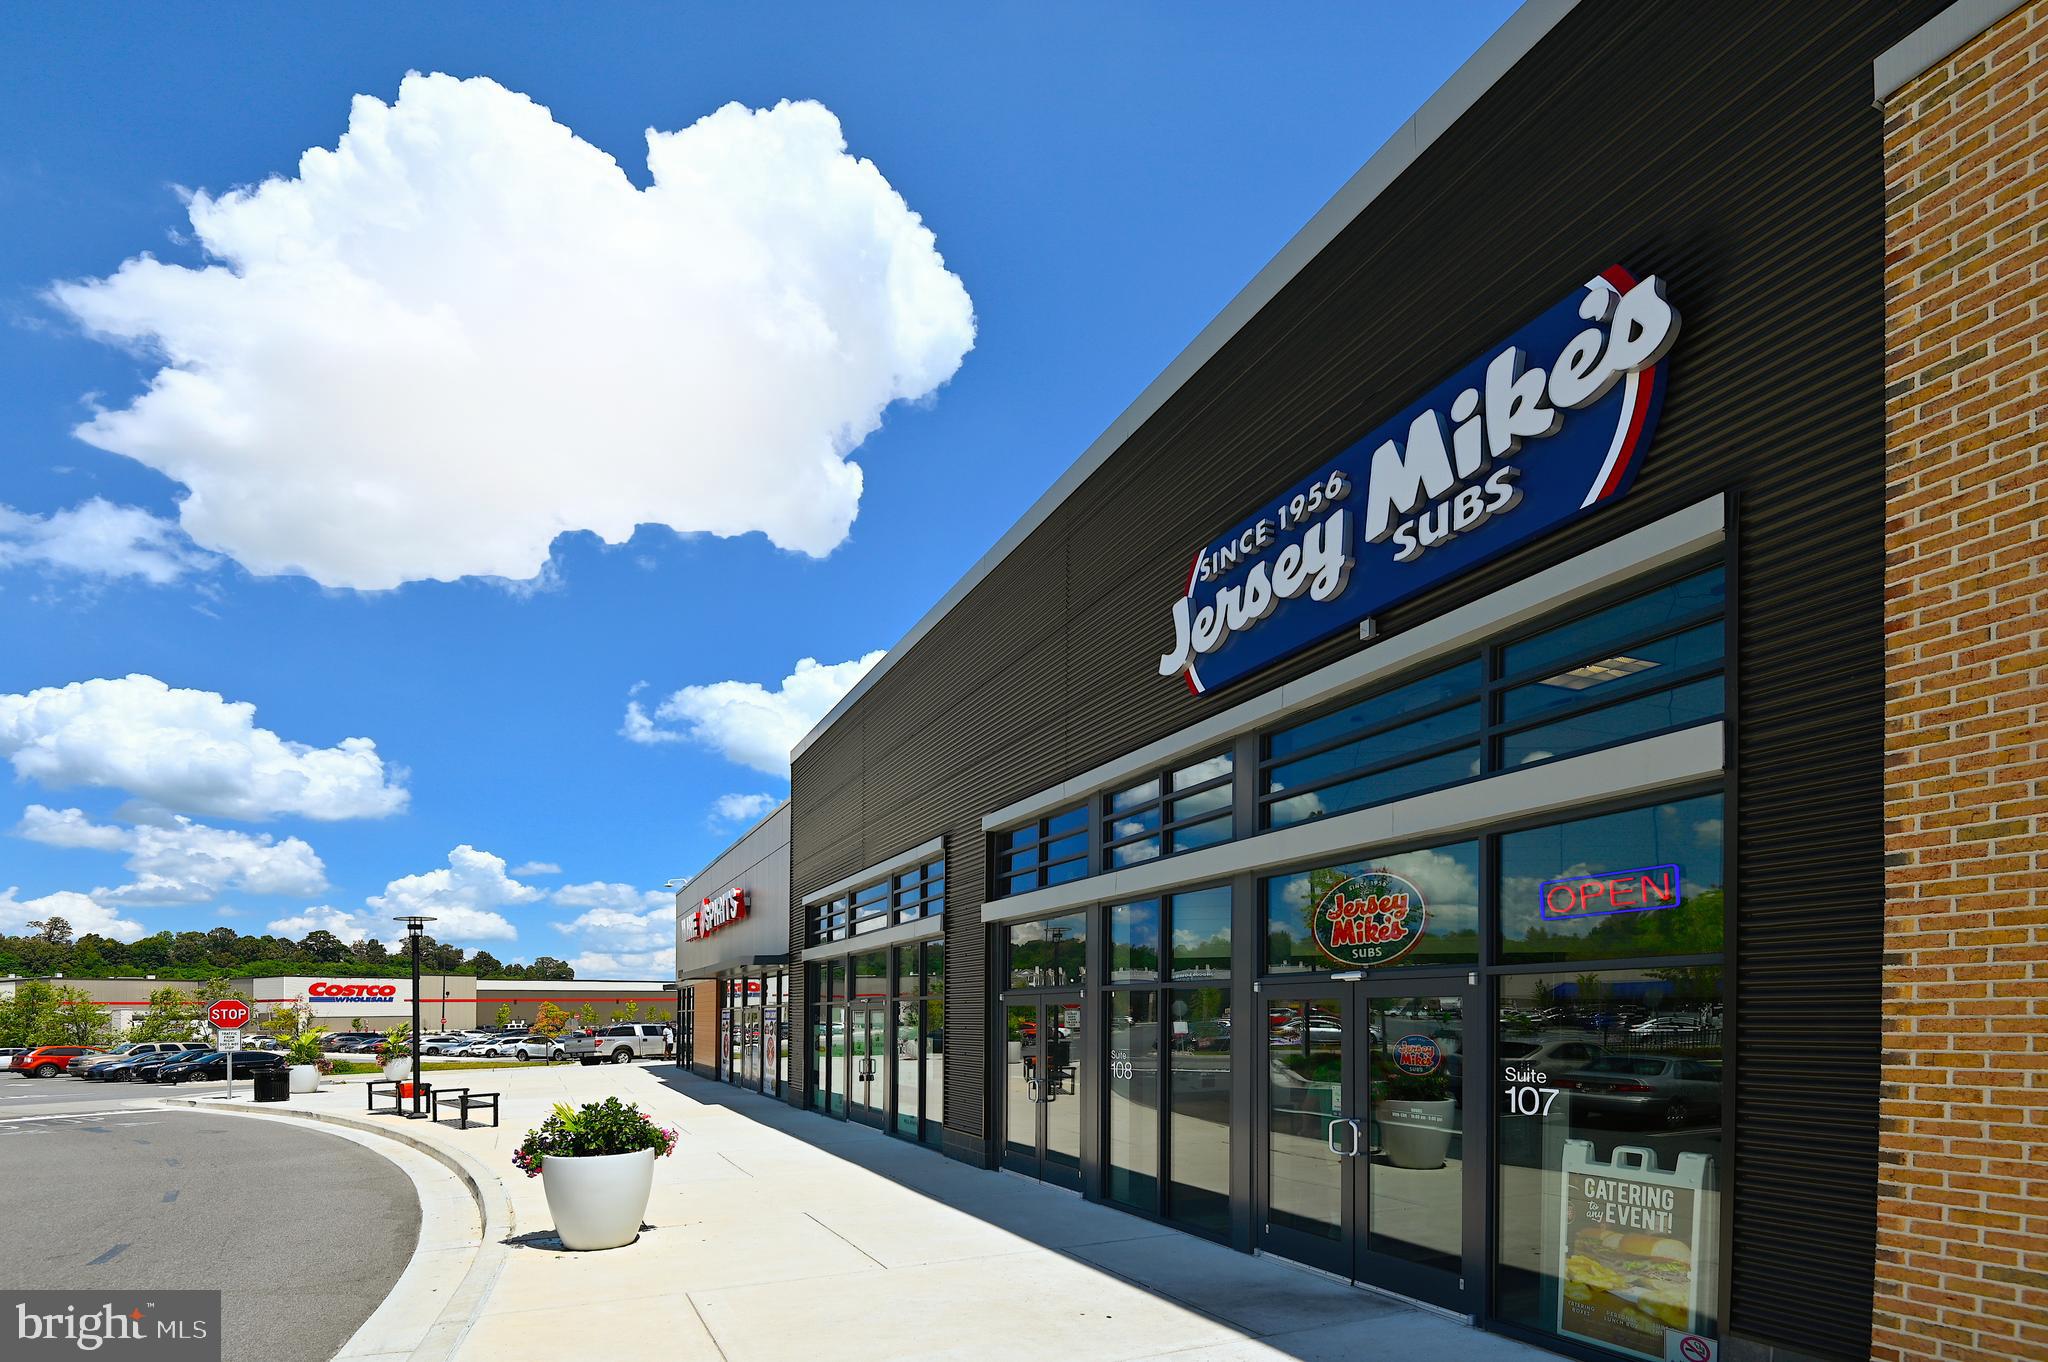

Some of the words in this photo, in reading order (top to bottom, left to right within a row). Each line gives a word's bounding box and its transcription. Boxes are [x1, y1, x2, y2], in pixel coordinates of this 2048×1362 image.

[1158, 508, 1352, 676] Jersey
[1365, 274, 1679, 543] Mike's
[1200, 520, 1273, 581] SINCE
[1278, 470, 1349, 531] 1956
[1393, 465, 1520, 562] SUBS
[1327, 893, 1409, 920] Jersey
[1547, 872, 1671, 913] OPEN
[1331, 915, 1408, 947] Mike's
[1352, 946, 1382, 959] SUBS
[211, 1009, 247, 1020] STOP
[1111, 1050, 1127, 1059] Suite
[1111, 1061, 1132, 1080] 108
[1504, 1066, 1547, 1084] Suite
[1504, 1086, 1560, 1116] 107
[1584, 1177, 1674, 1210] CATERING
[1587, 1201, 1599, 1210] to
[1586, 1210, 1604, 1223] any
[1605, 1202, 1673, 1234] EVENT!
